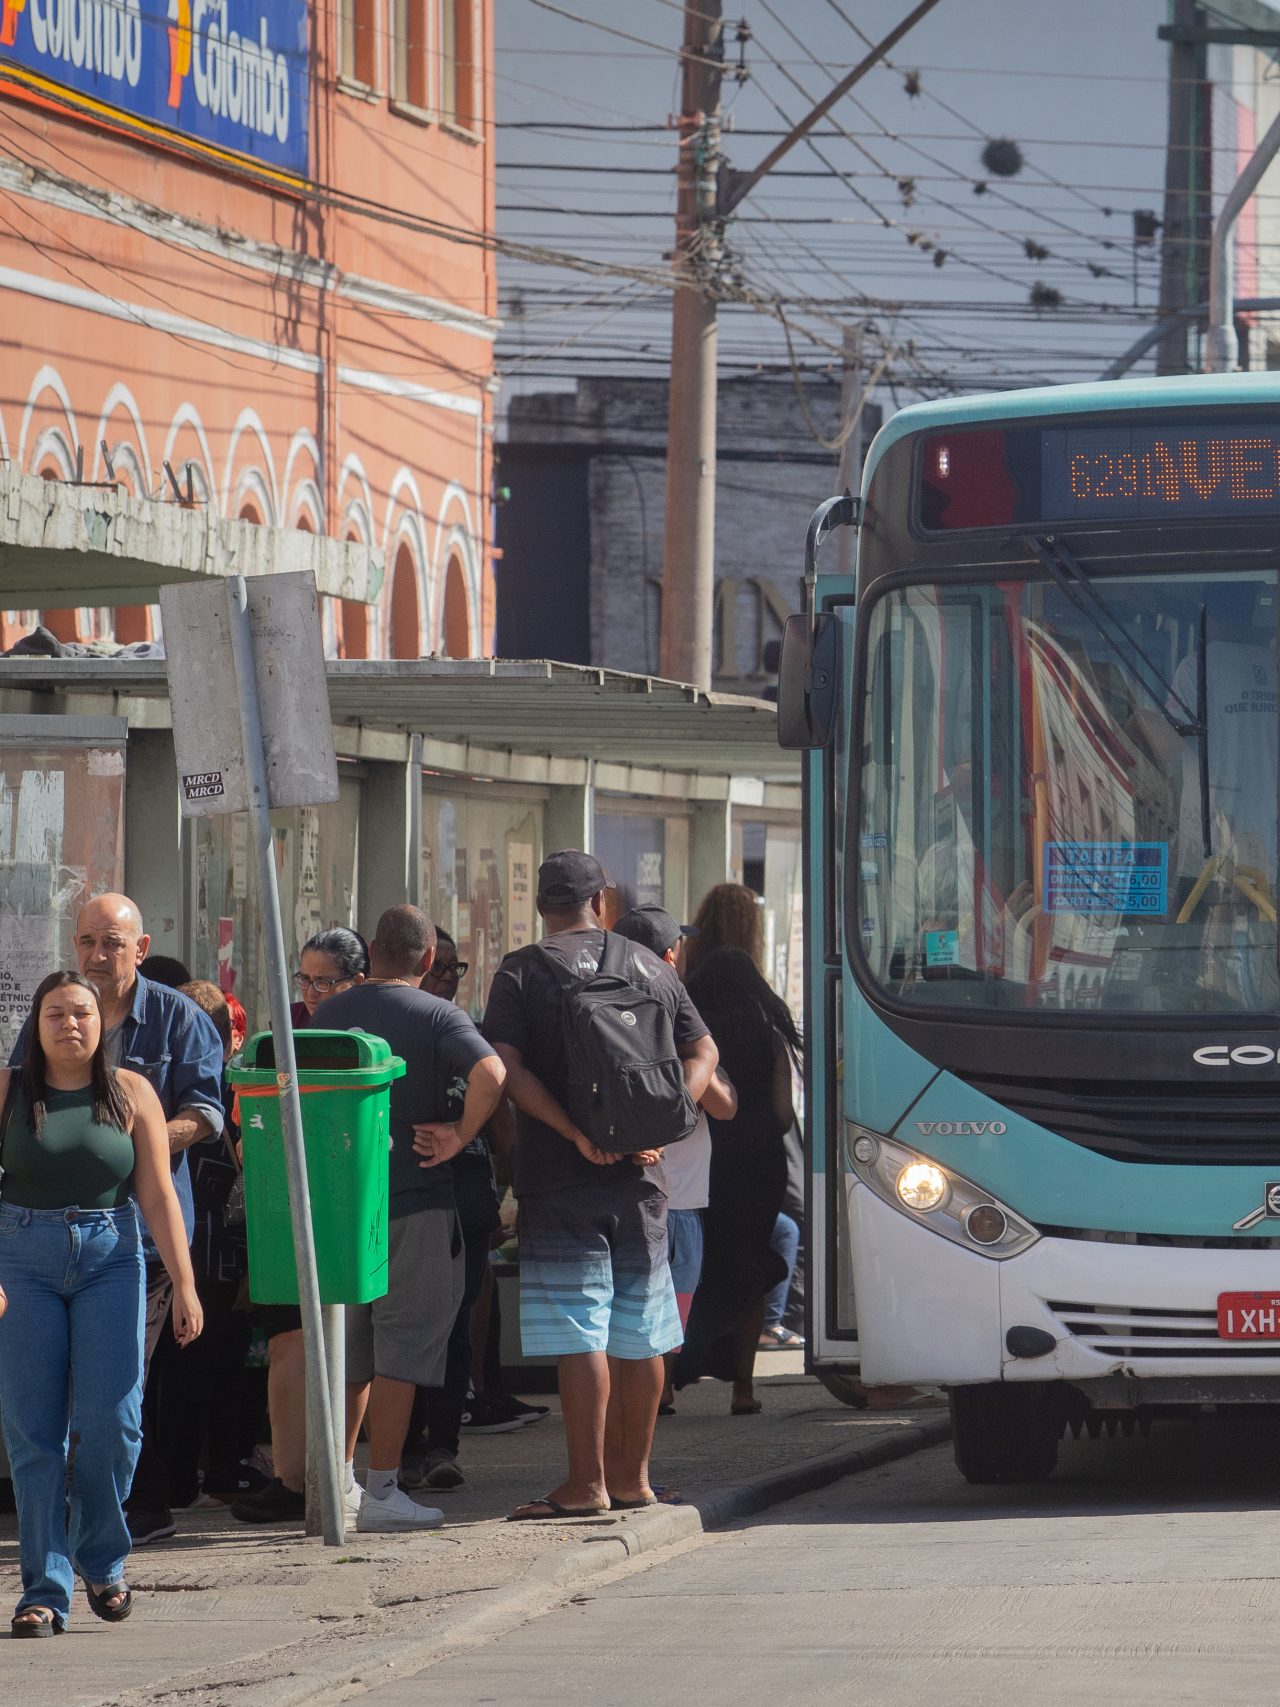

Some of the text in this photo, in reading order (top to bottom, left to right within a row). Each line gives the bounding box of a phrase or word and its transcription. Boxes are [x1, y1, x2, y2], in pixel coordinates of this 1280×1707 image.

[193, 0, 290, 144] Colombo
[1224, 703, 1248, 714] QUE
[186, 773, 220, 786] MRCD
[188, 785, 222, 798] MRCD
[1067, 849, 1137, 865] TARIFA
[1129, 874, 1158, 886] 6,00
[1128, 896, 1158, 908] 5,00
[914, 1121, 1007, 1135] VOLVO
